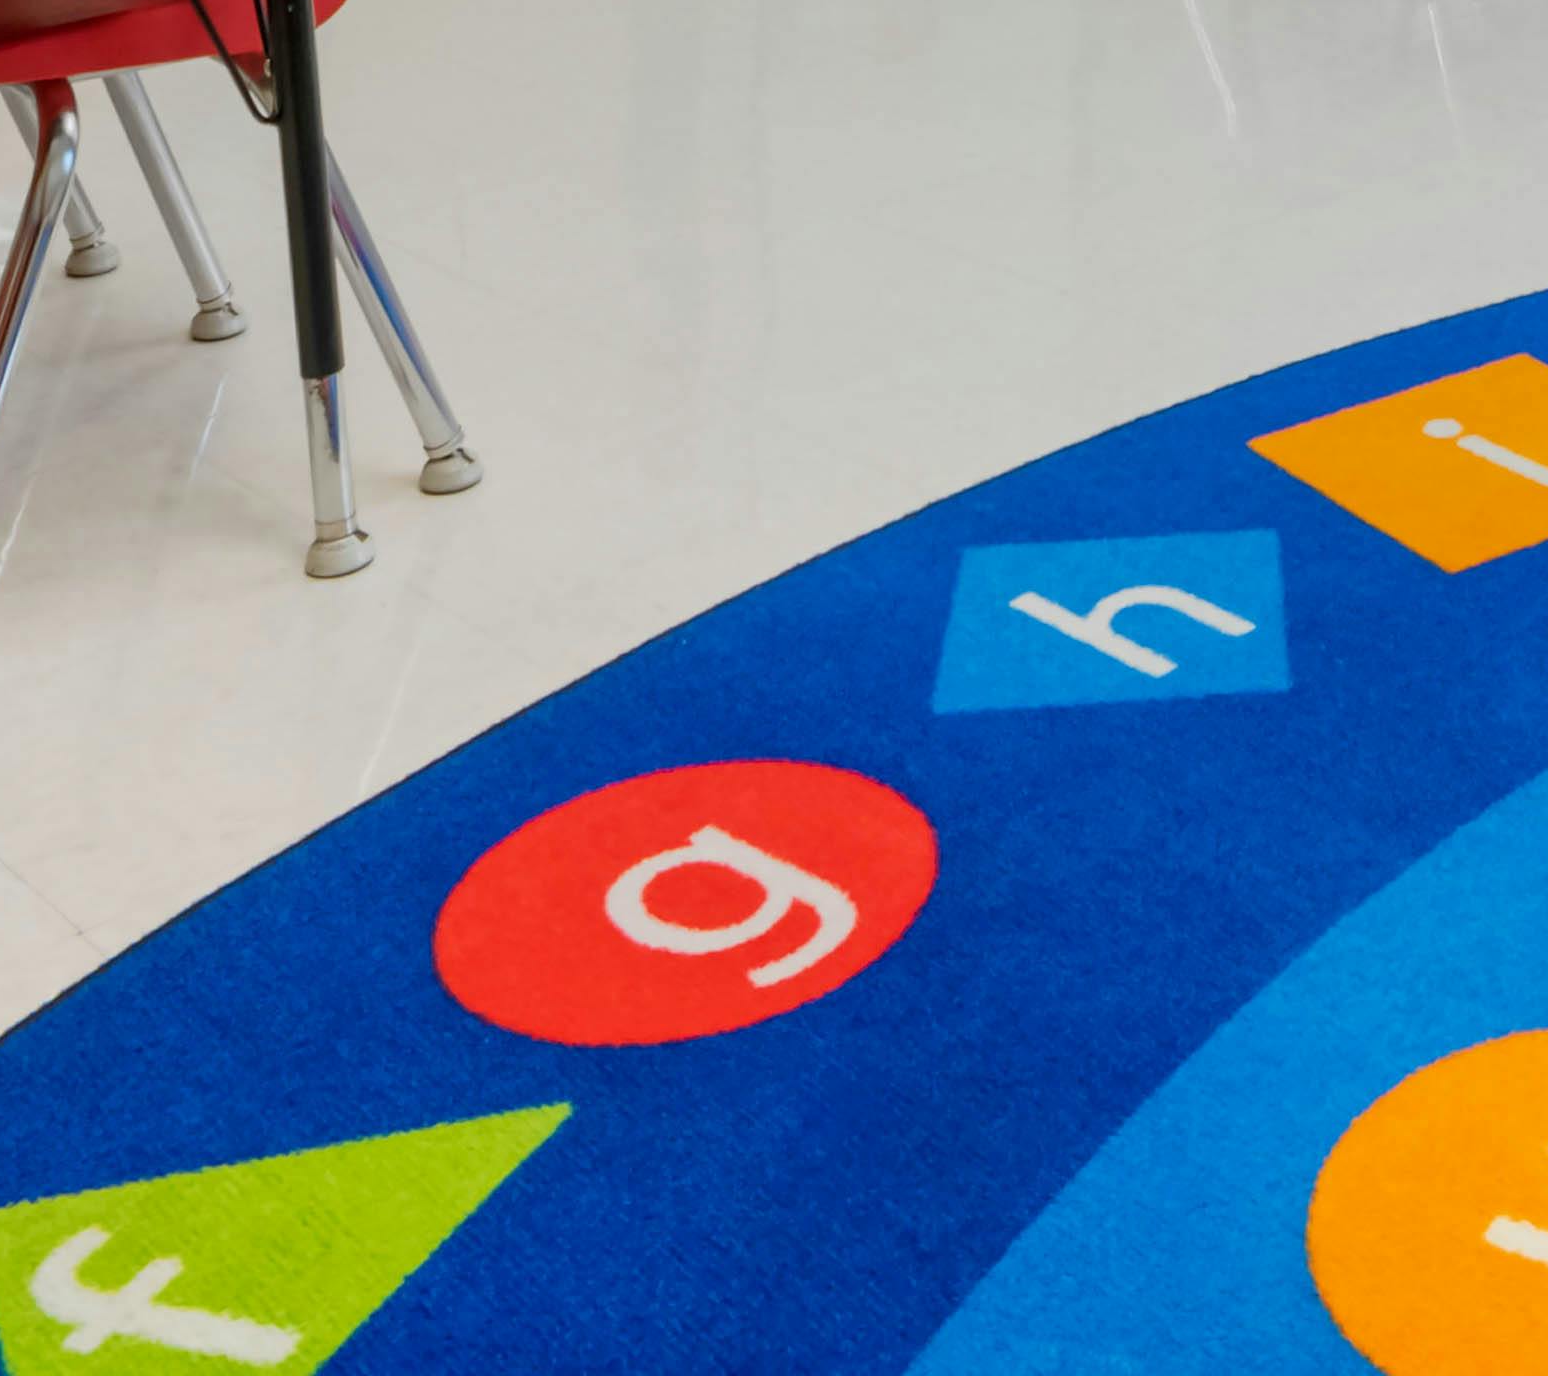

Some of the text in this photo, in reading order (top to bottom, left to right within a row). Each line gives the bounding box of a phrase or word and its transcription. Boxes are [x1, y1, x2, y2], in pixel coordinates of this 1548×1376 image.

[1009, 585, 1255, 678] h
[605, 826, 857, 987] g
[30, 1228, 300, 1365] f
